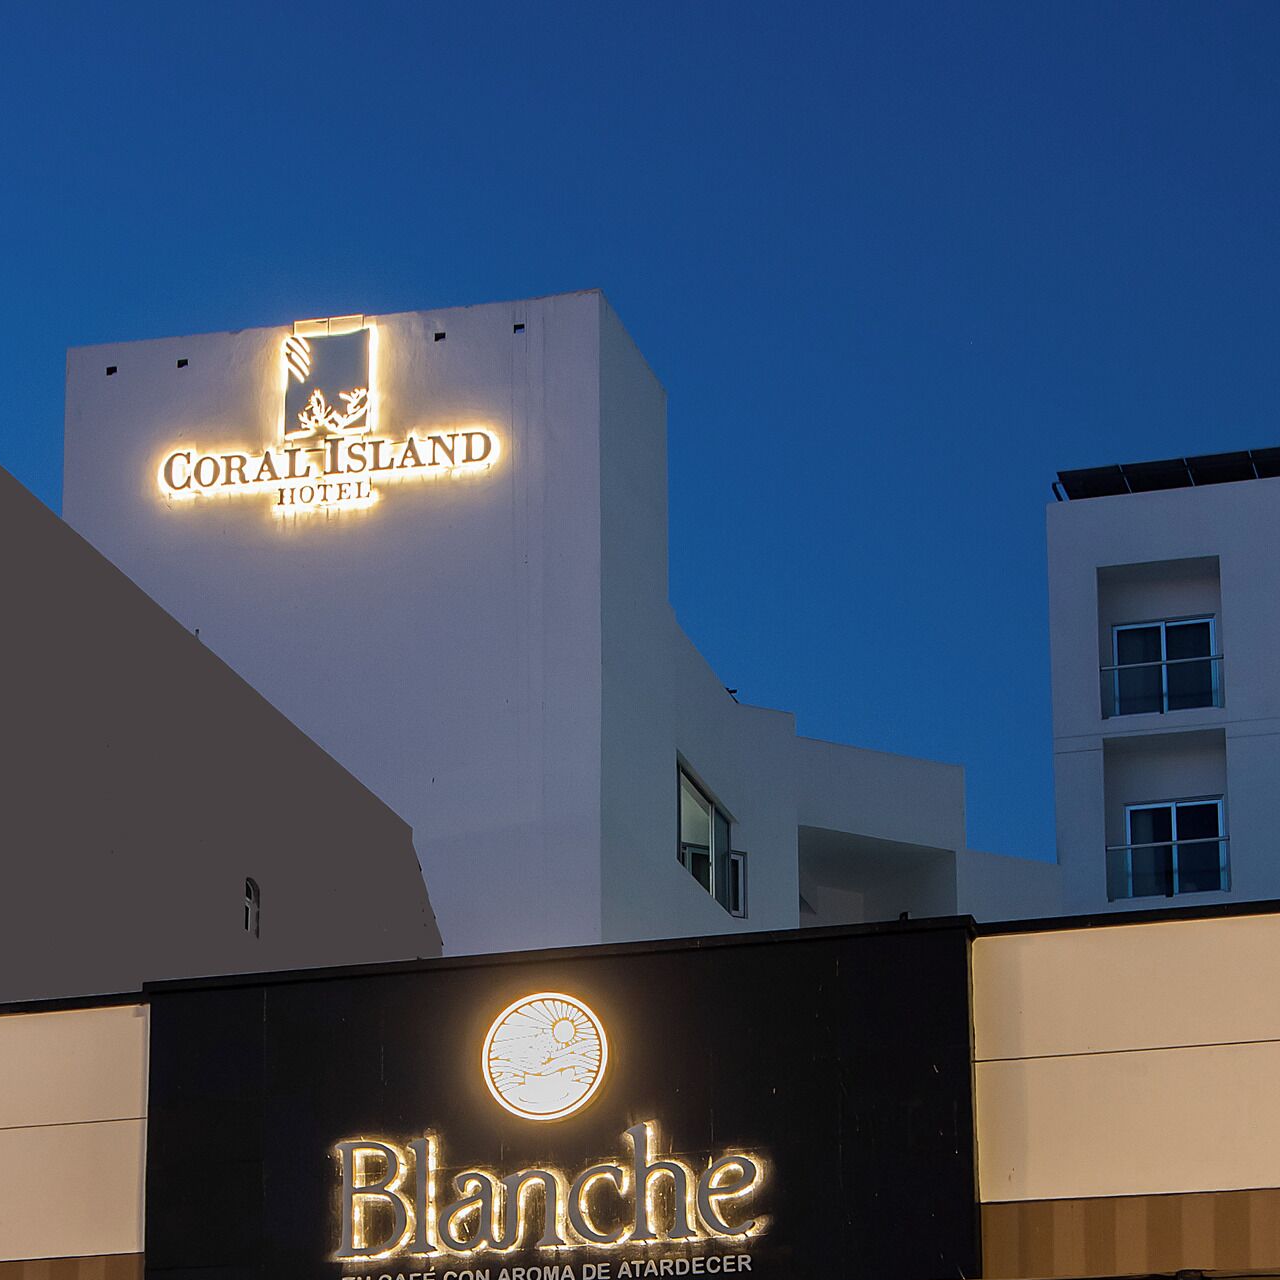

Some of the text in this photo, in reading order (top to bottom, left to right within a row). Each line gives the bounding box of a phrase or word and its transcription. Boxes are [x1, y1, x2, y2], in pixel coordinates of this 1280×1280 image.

[163, 431, 492, 491] CORAL ISLAND
[276, 481, 371, 505] HOTEL
[334, 1120, 763, 1258] Blanche
[582, 1263, 611, 1280] DE
[617, 1254, 753, 1279] ATARDECER
